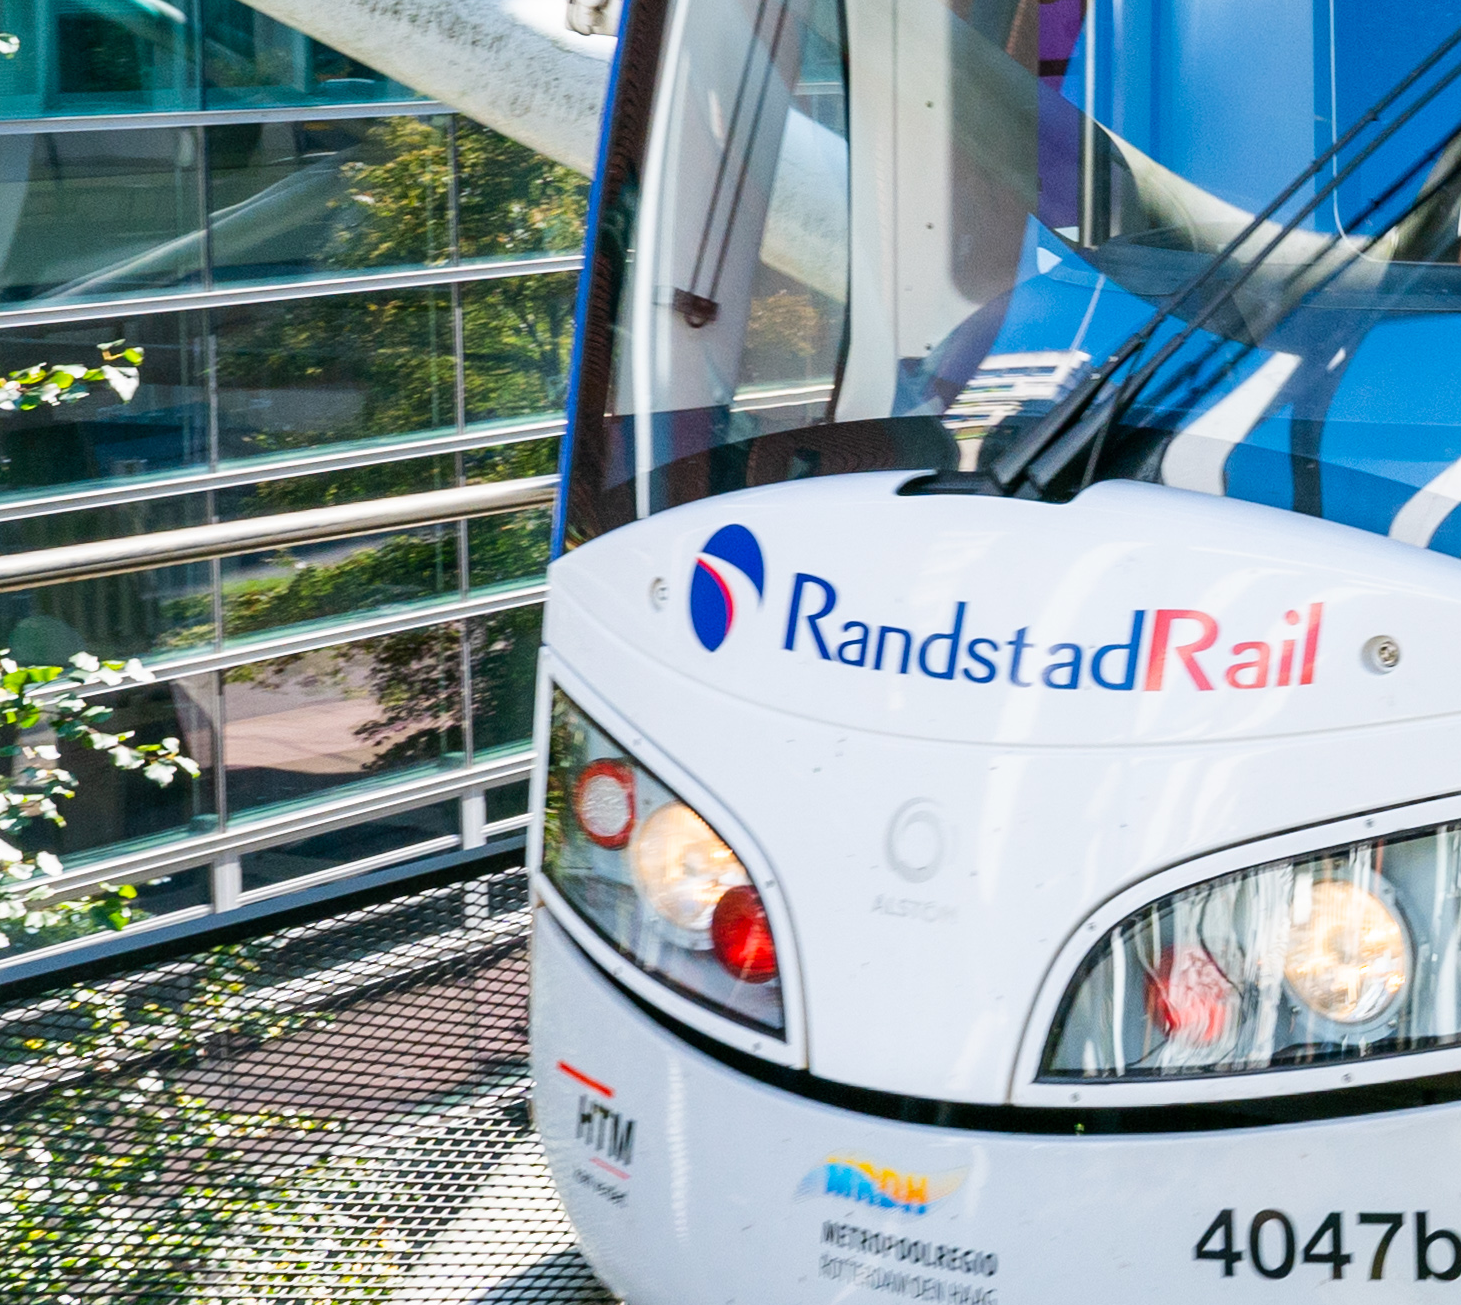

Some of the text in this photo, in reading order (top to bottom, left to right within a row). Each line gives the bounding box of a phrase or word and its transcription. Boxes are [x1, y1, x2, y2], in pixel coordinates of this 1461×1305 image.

[781, 571, 1326, 693] RandstadRail
[576, 1094, 637, 1166] HTM
[820, 1219, 1000, 1278] METROPOOLREGIO
